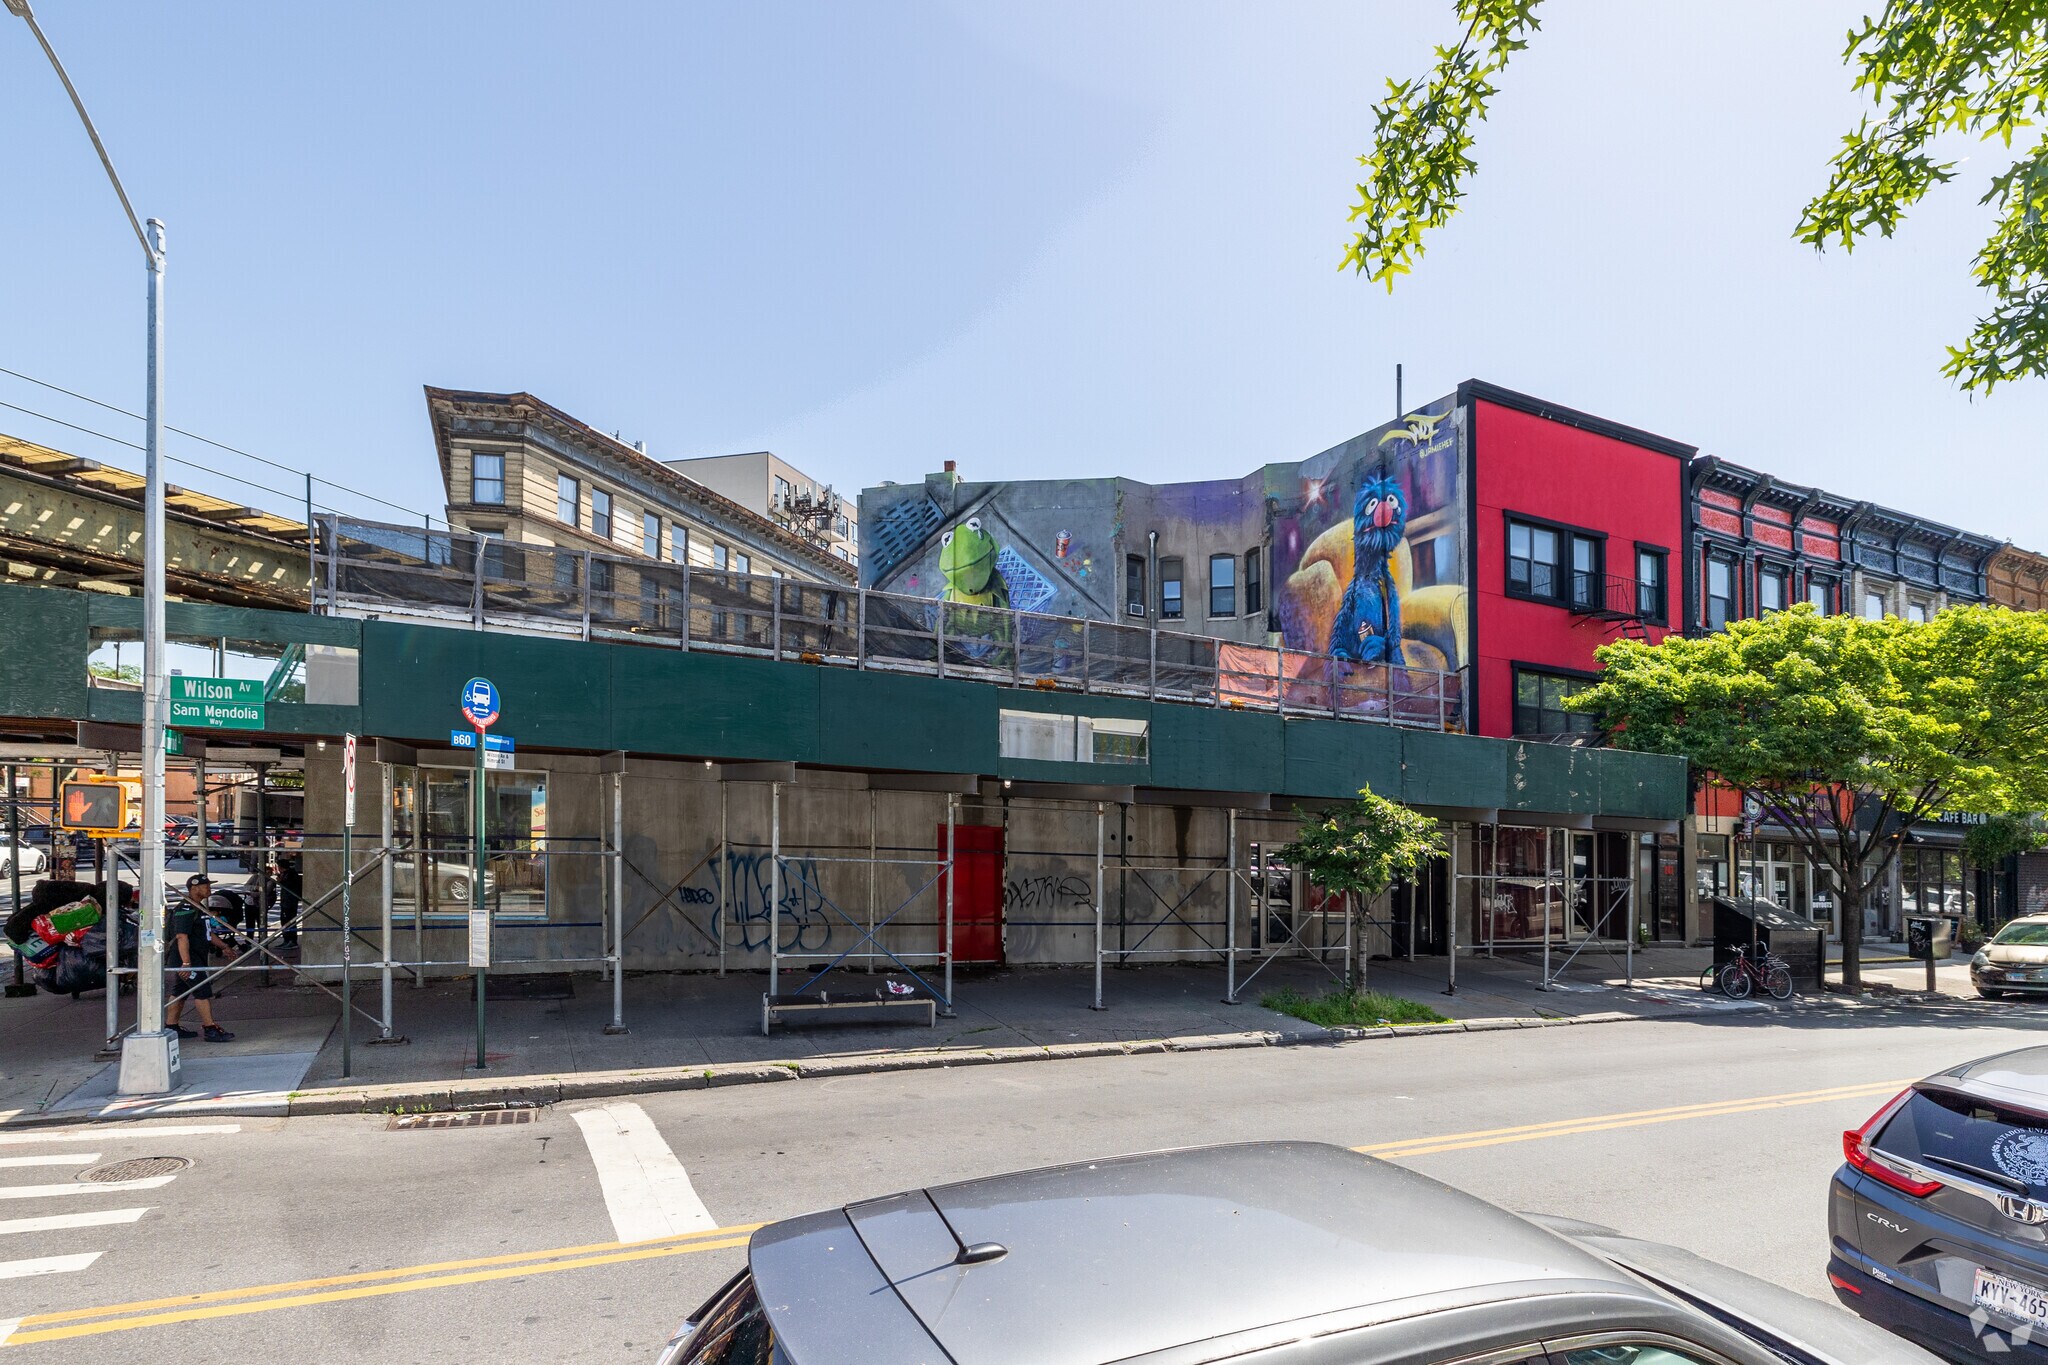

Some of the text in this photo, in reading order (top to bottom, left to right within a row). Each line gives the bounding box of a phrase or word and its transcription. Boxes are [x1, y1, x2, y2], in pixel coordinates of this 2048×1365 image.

[183, 679, 251, 700] Wilson Av
[173, 703, 259, 720] Sam Mendolia
[209, 718, 223, 727] Way
[453, 733, 471, 746] B60
[1938, 811, 1960, 824] CAFE
[1961, 812, 1979, 825] BAR
[1994, 1127, 2026, 1145] ESTADOS
[1866, 1212, 1909, 1233] CR-V
[1998, 1279, 2043, 1299] NEW YORK
